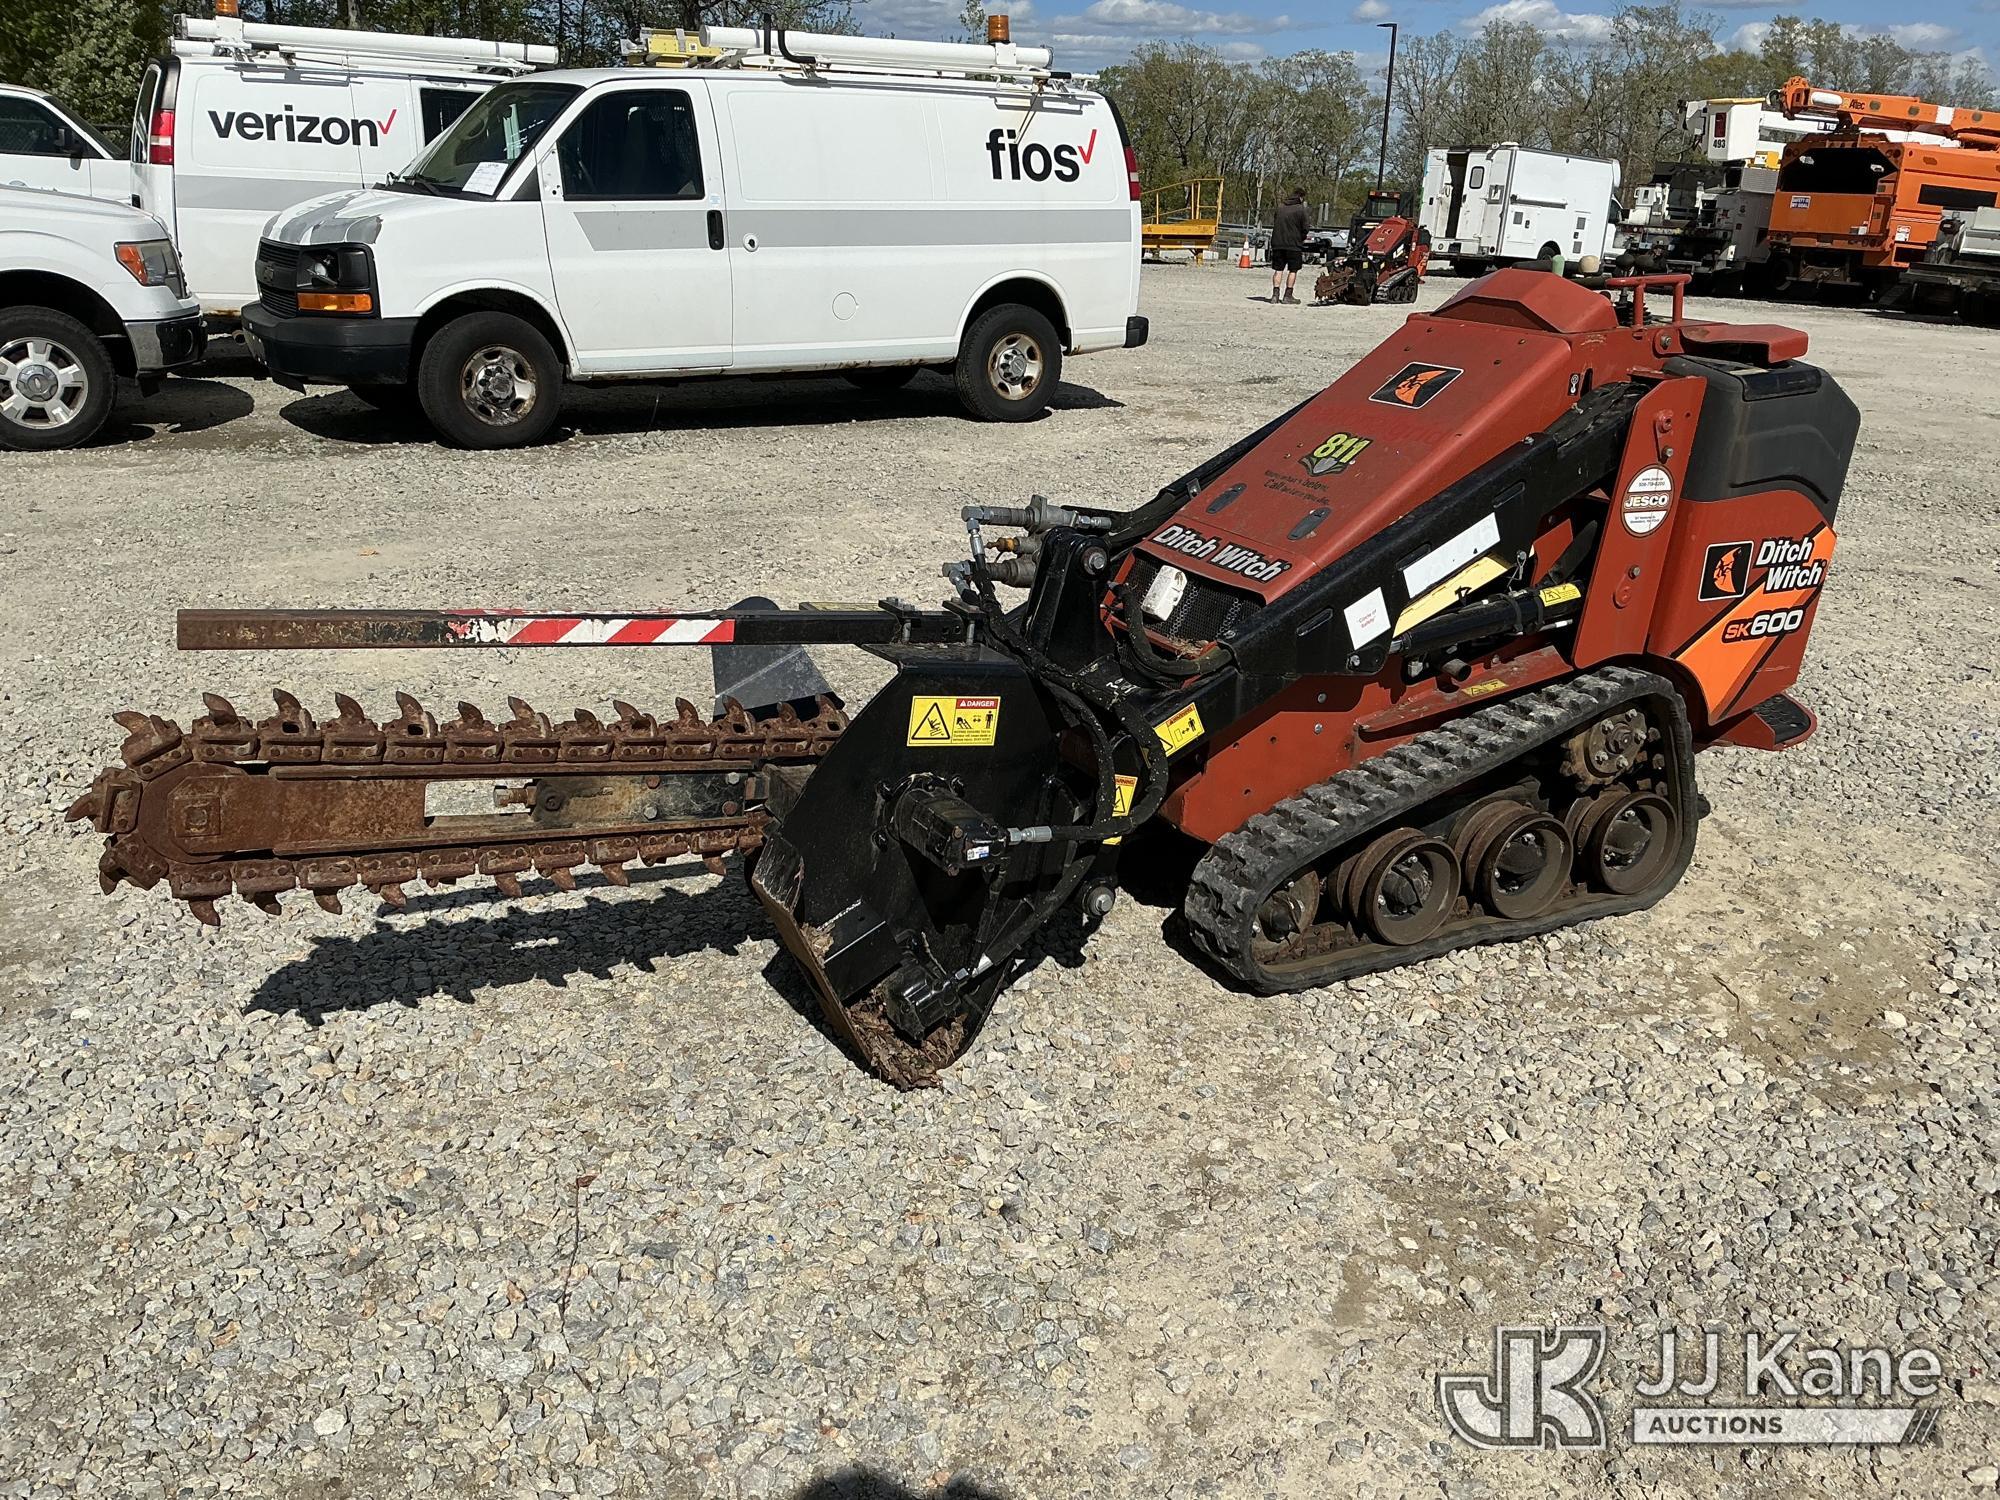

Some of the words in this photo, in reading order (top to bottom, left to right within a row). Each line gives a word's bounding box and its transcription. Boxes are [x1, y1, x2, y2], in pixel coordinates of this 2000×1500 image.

[1849, 98, 1866, 110] Altec
[207, 104, 379, 147] verizon
[985, 128, 1080, 182] fios
[1712, 139, 1726, 149] 493
[1312, 432, 1372, 464] 811
[1625, 494, 1668, 508] JESCO
[1151, 524, 1218, 559] Ditch
[1755, 537, 1813, 566] Ditch
[1724, 609, 1804, 639] SK600
